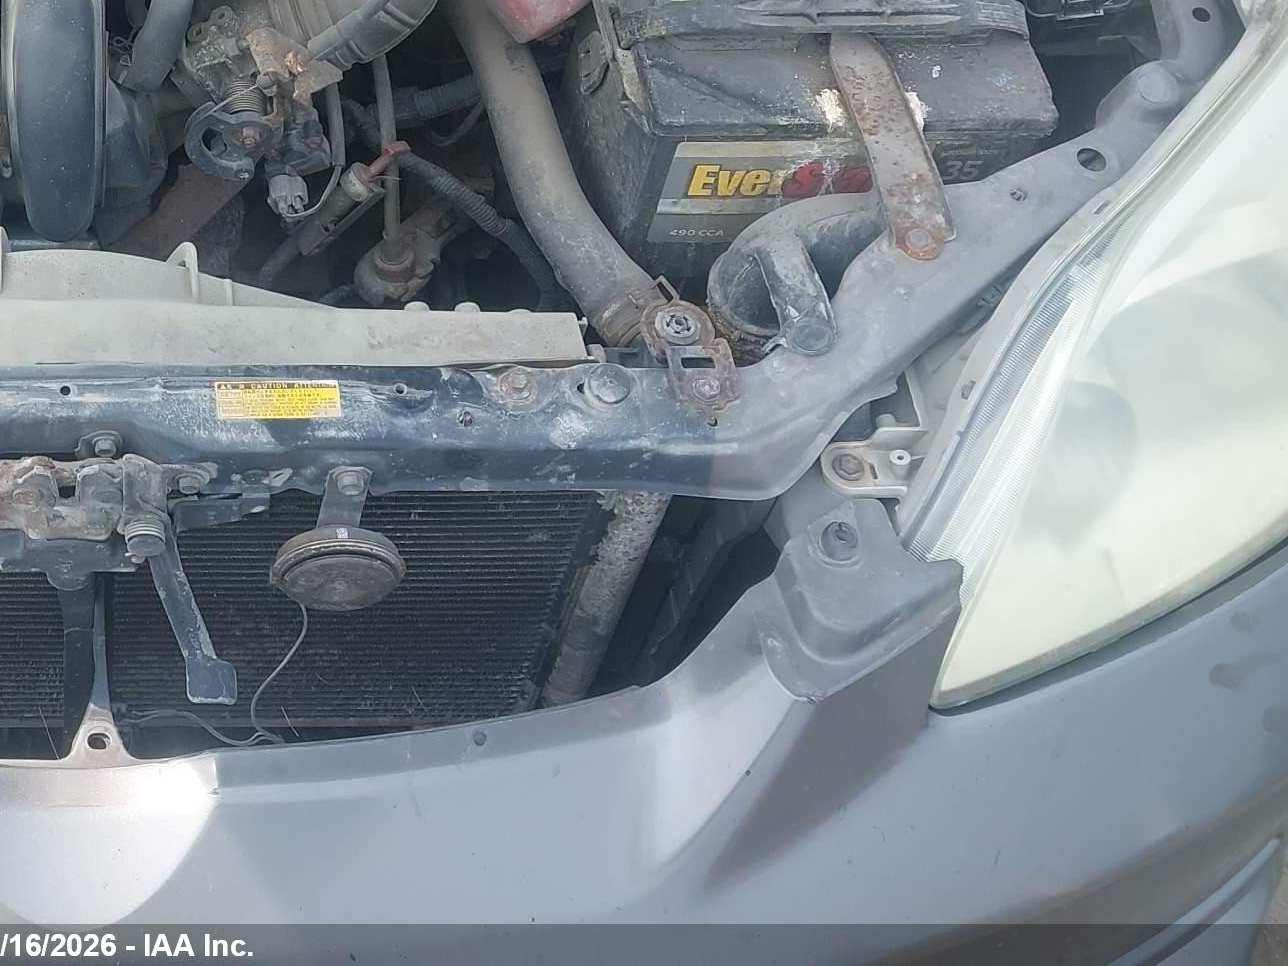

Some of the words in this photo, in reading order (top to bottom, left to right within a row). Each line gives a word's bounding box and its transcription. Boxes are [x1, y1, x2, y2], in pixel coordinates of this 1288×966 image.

[943, 160, 985, 181] 35
[669, 229, 695, 237] 490
[697, 229, 725, 237] CCA
